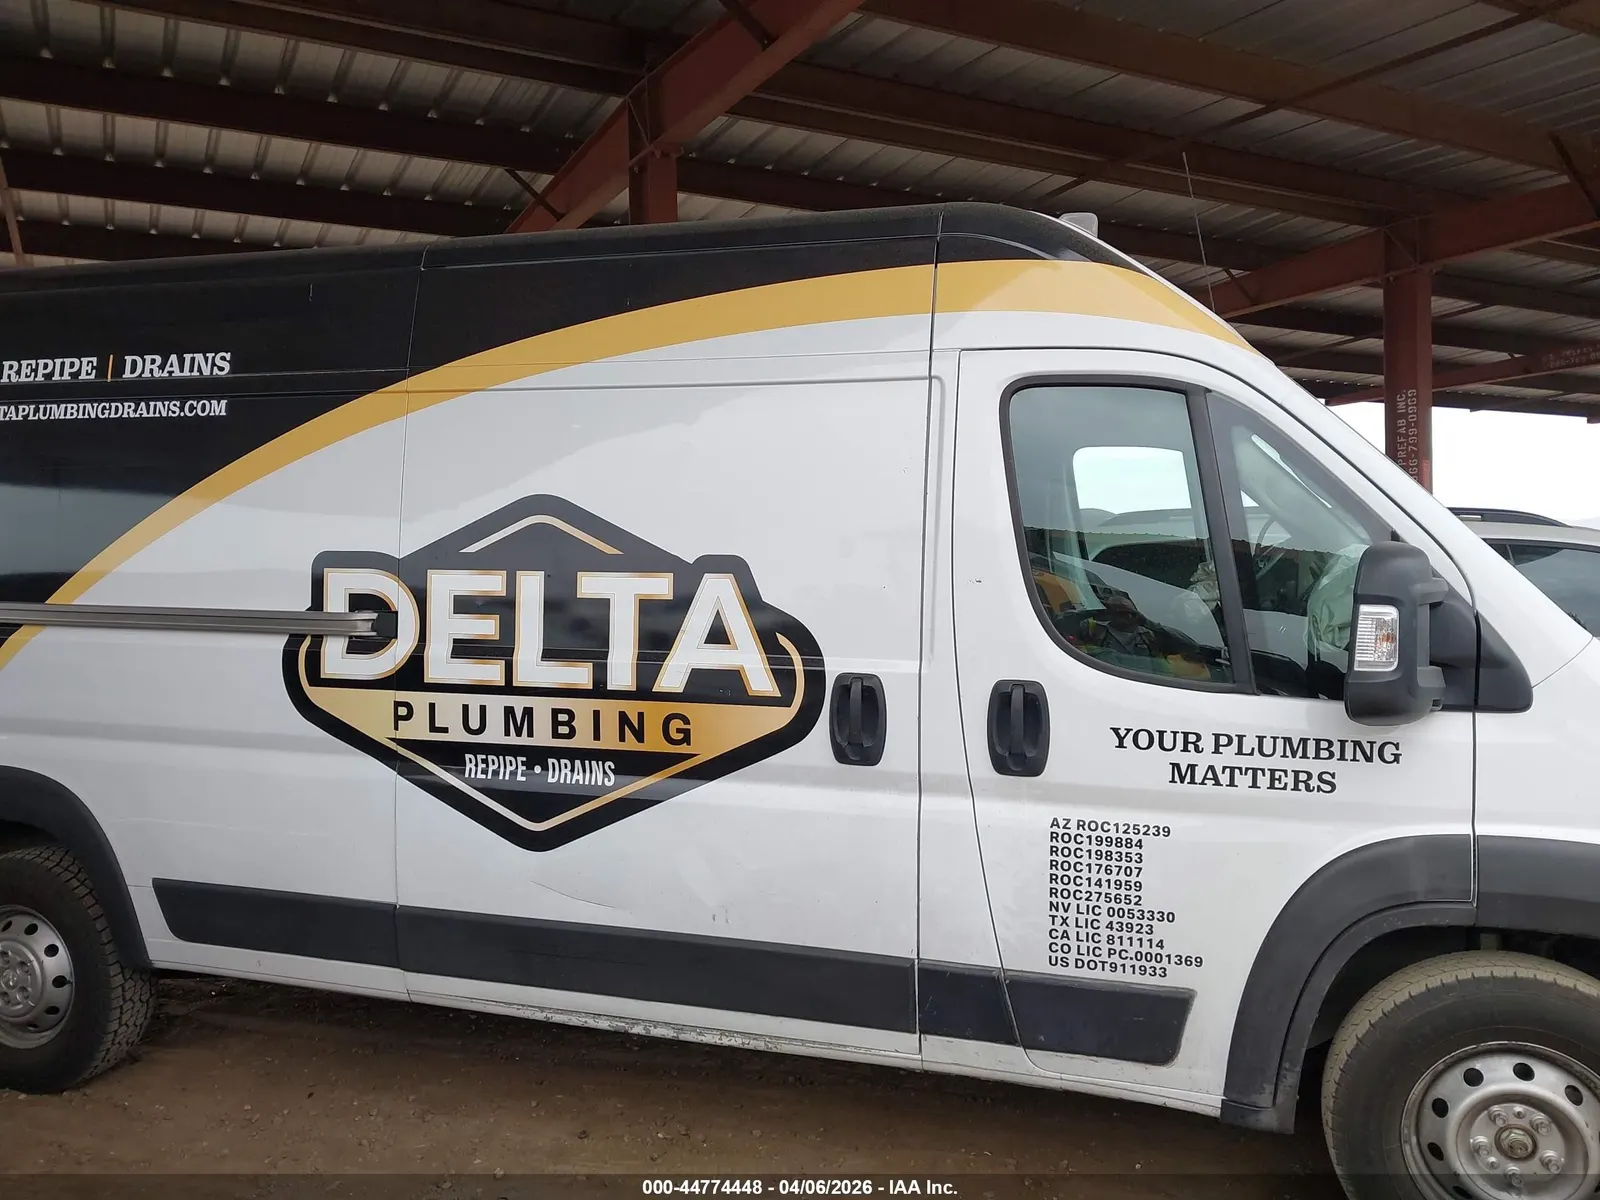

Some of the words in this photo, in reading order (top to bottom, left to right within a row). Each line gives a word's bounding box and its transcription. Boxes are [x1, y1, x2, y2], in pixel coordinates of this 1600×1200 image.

[0, 357, 97, 383] REPIPE
[122, 352, 231, 379] DRAINS
[1396, 390, 1406, 413] INC.
[1396, 419, 1407, 466] PREFAB
[320, 568, 781, 697] DELTA
[393, 700, 693, 746] PLUMBING
[1110, 727, 1204, 754] YOUR
[1211, 732, 1402, 765] PLUMBING
[464, 753, 527, 783] REPIPE
[547, 757, 616, 787] DRAINS
[1169, 762, 1337, 794] MATTERS
[1050, 817, 1072, 830] AZ
[1076, 819, 1171, 837] ROC125239
[1050, 831, 1143, 850] ROC199884
[1049, 845, 1143, 864] ROC198353
[1049, 859, 1143, 878] ROC176707
[1049, 873, 1143, 892] ROC141959
[1049, 887, 1142, 906] ROC275652
[1049, 901, 1071, 913] NV
[1076, 903, 1102, 916] LIC
[1106, 906, 1176, 923] 0053330
[1049, 914, 1070, 927] TX
[1075, 917, 1101, 930] LIC
[1105, 921, 1154, 935] 43923
[1048, 928, 1071, 941] CA
[1076, 931, 1102, 944] LIC
[1106, 935, 1165, 950] 811114
[1048, 942, 1072, 954] CO
[1077, 944, 1102, 957] LIC
[1107, 948, 1203, 967] PC.0001369
[1048, 955, 1070, 968] US
[1075, 958, 1168, 978] DOT911933
